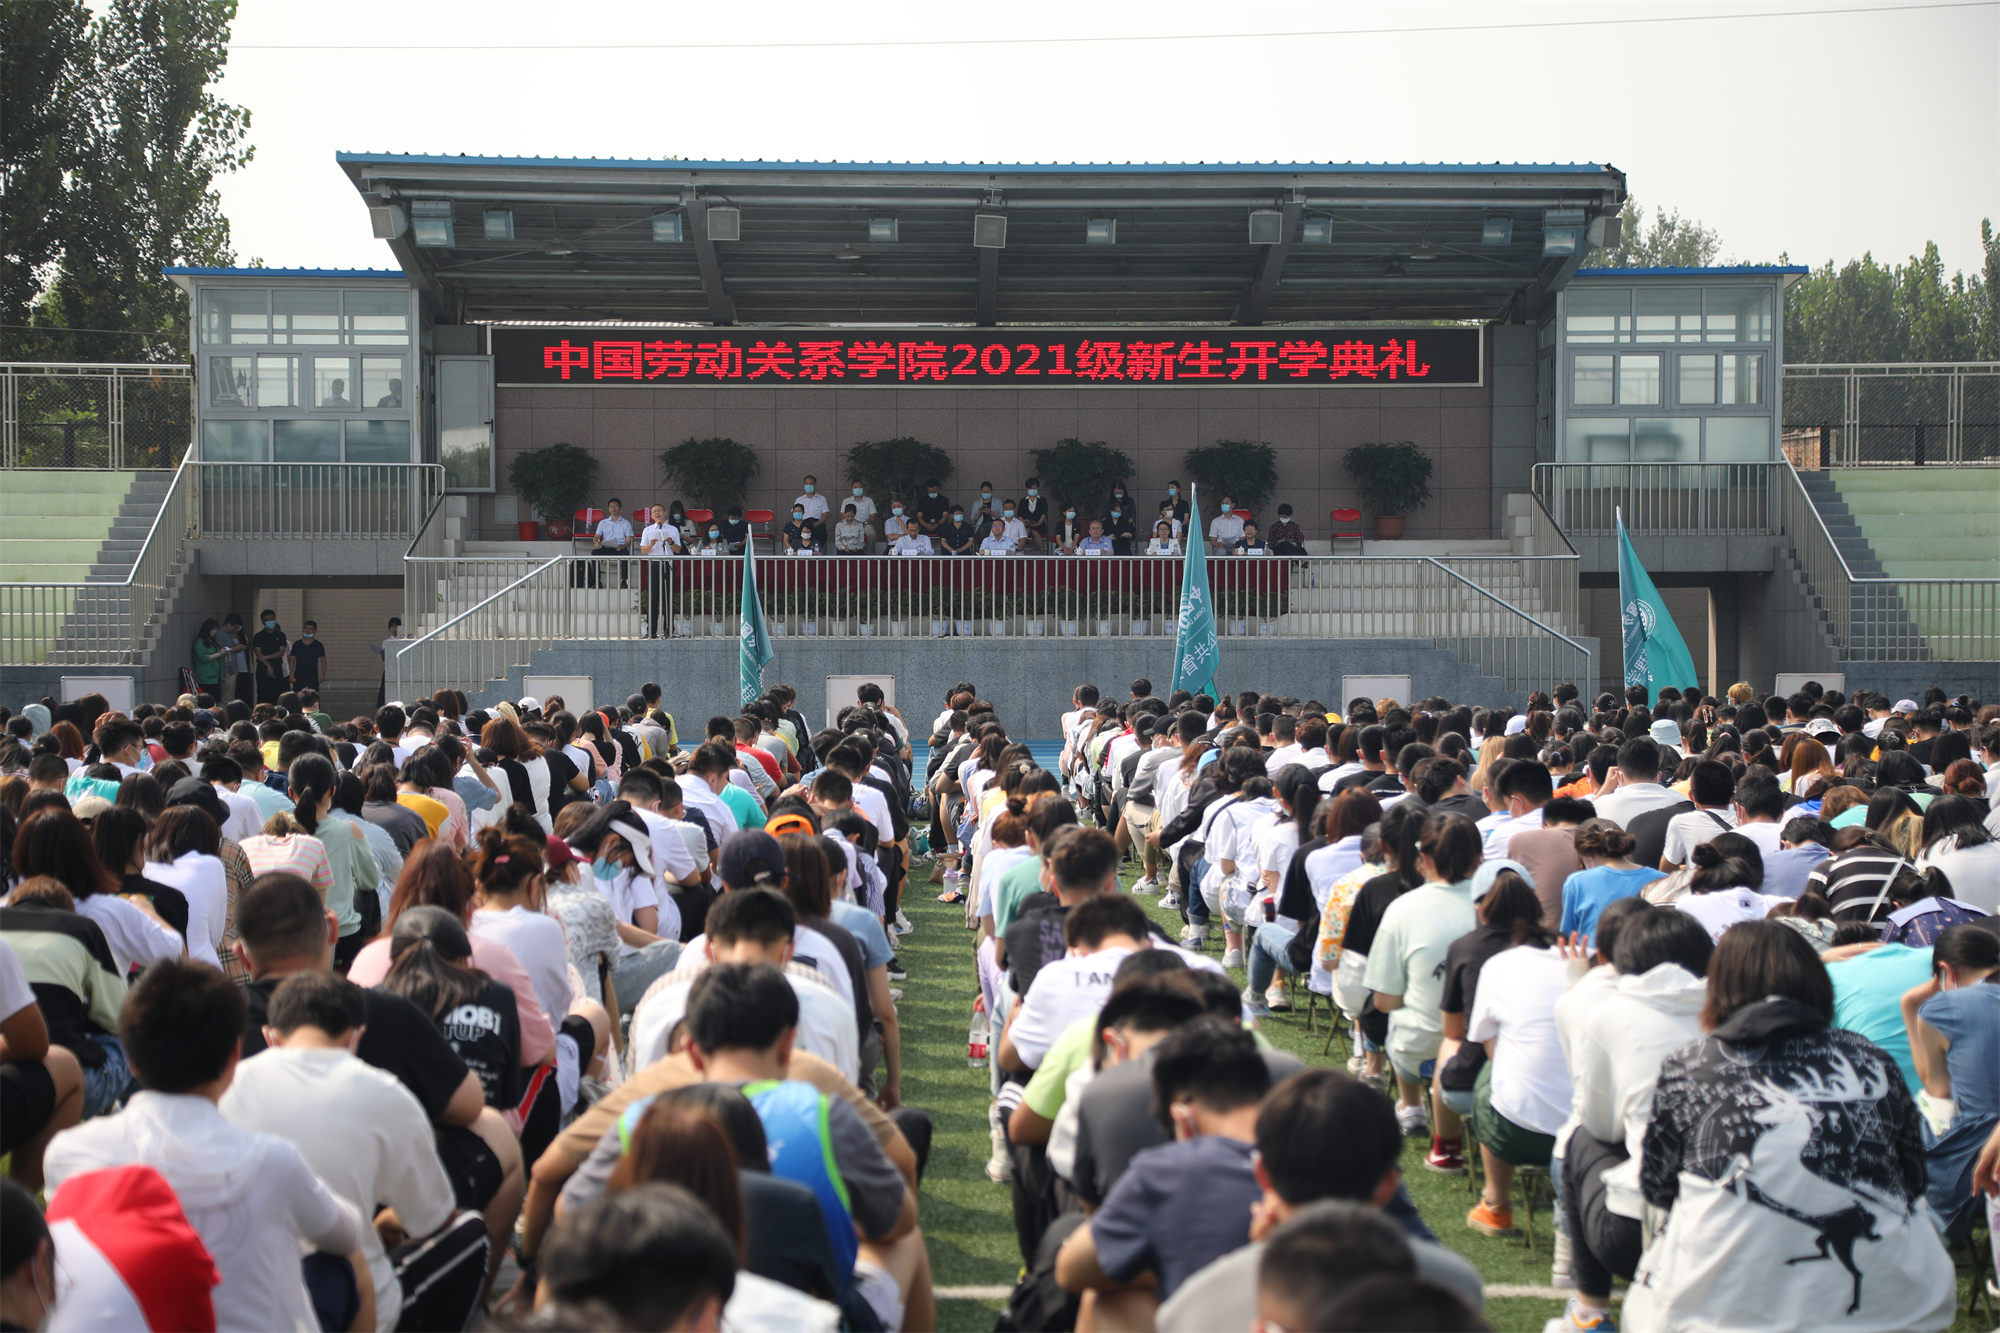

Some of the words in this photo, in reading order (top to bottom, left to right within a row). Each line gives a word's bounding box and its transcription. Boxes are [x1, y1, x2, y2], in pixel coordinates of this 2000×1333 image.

[543, 339, 1430, 380] 中国劳动关系学院2021级新生开学典礼
